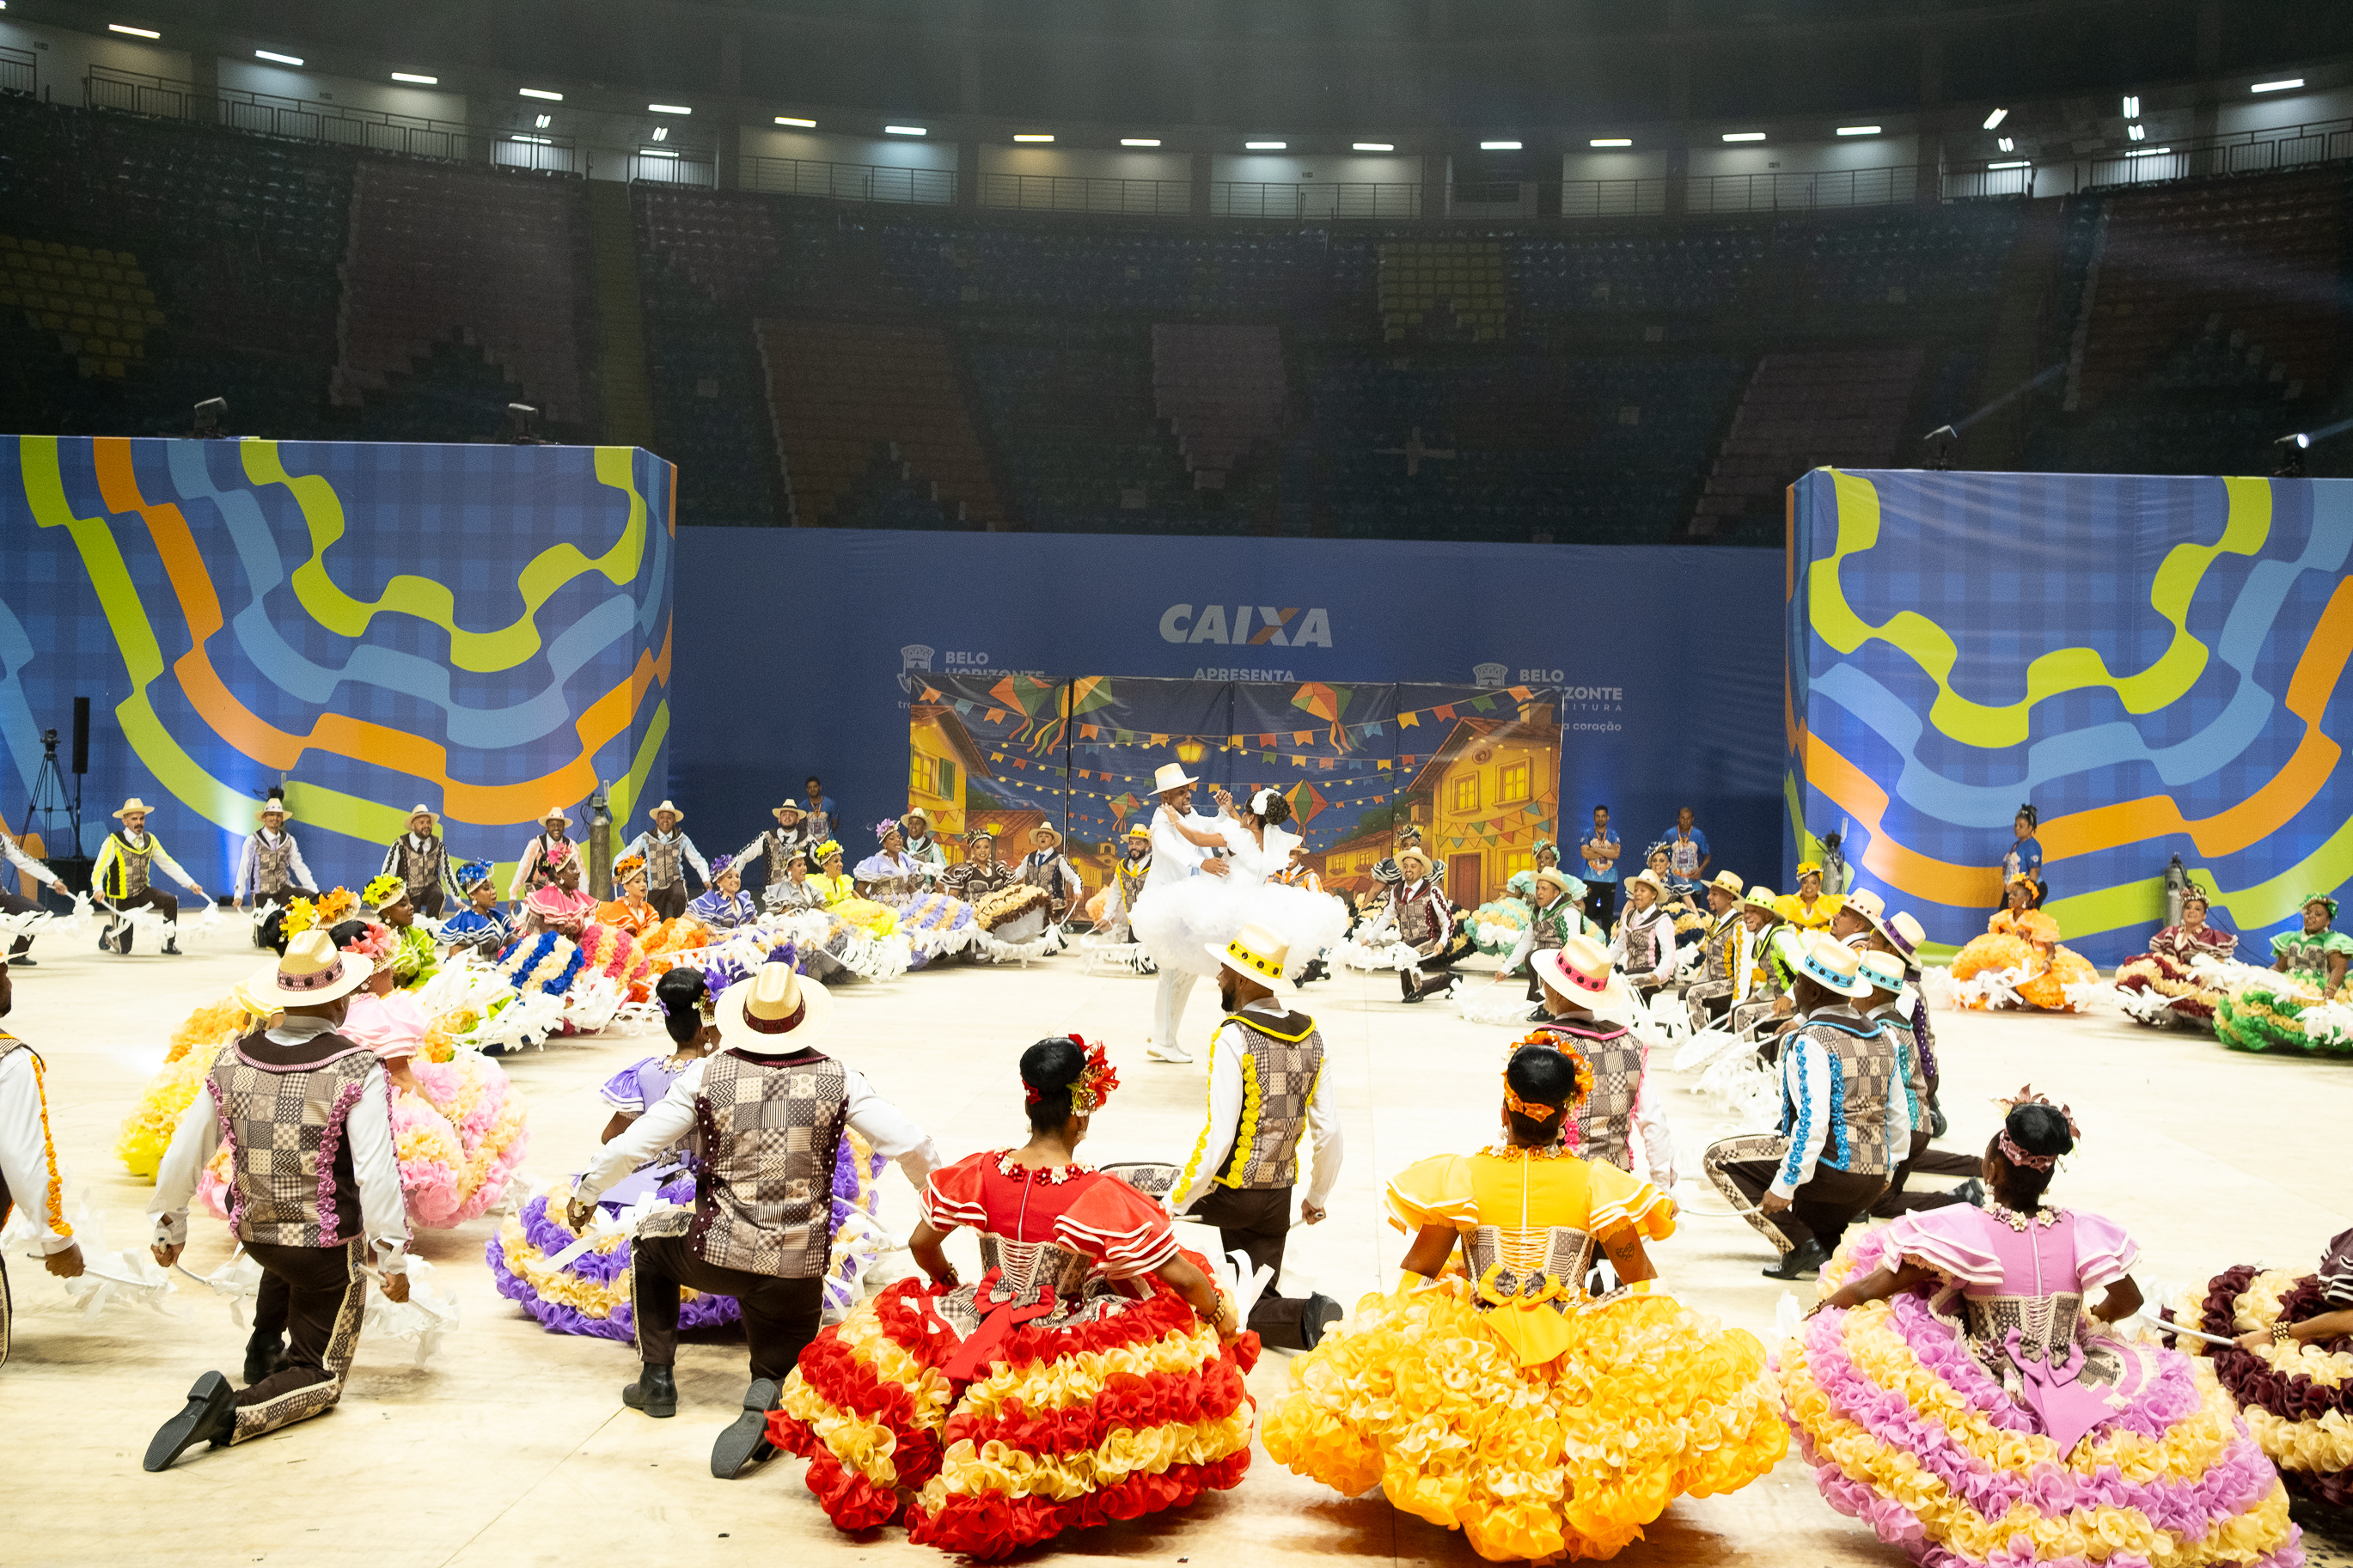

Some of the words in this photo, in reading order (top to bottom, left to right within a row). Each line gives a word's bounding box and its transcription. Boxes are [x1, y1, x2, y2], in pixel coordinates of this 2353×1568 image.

[1159, 603, 1333, 647] CAIXA
[945, 651, 989, 665] BELO
[1194, 668, 1295, 682] APRESENTA
[1519, 669, 1564, 683] BELO
[1563, 686, 1623, 700] ZONTE
[1573, 721, 1622, 734] coração
